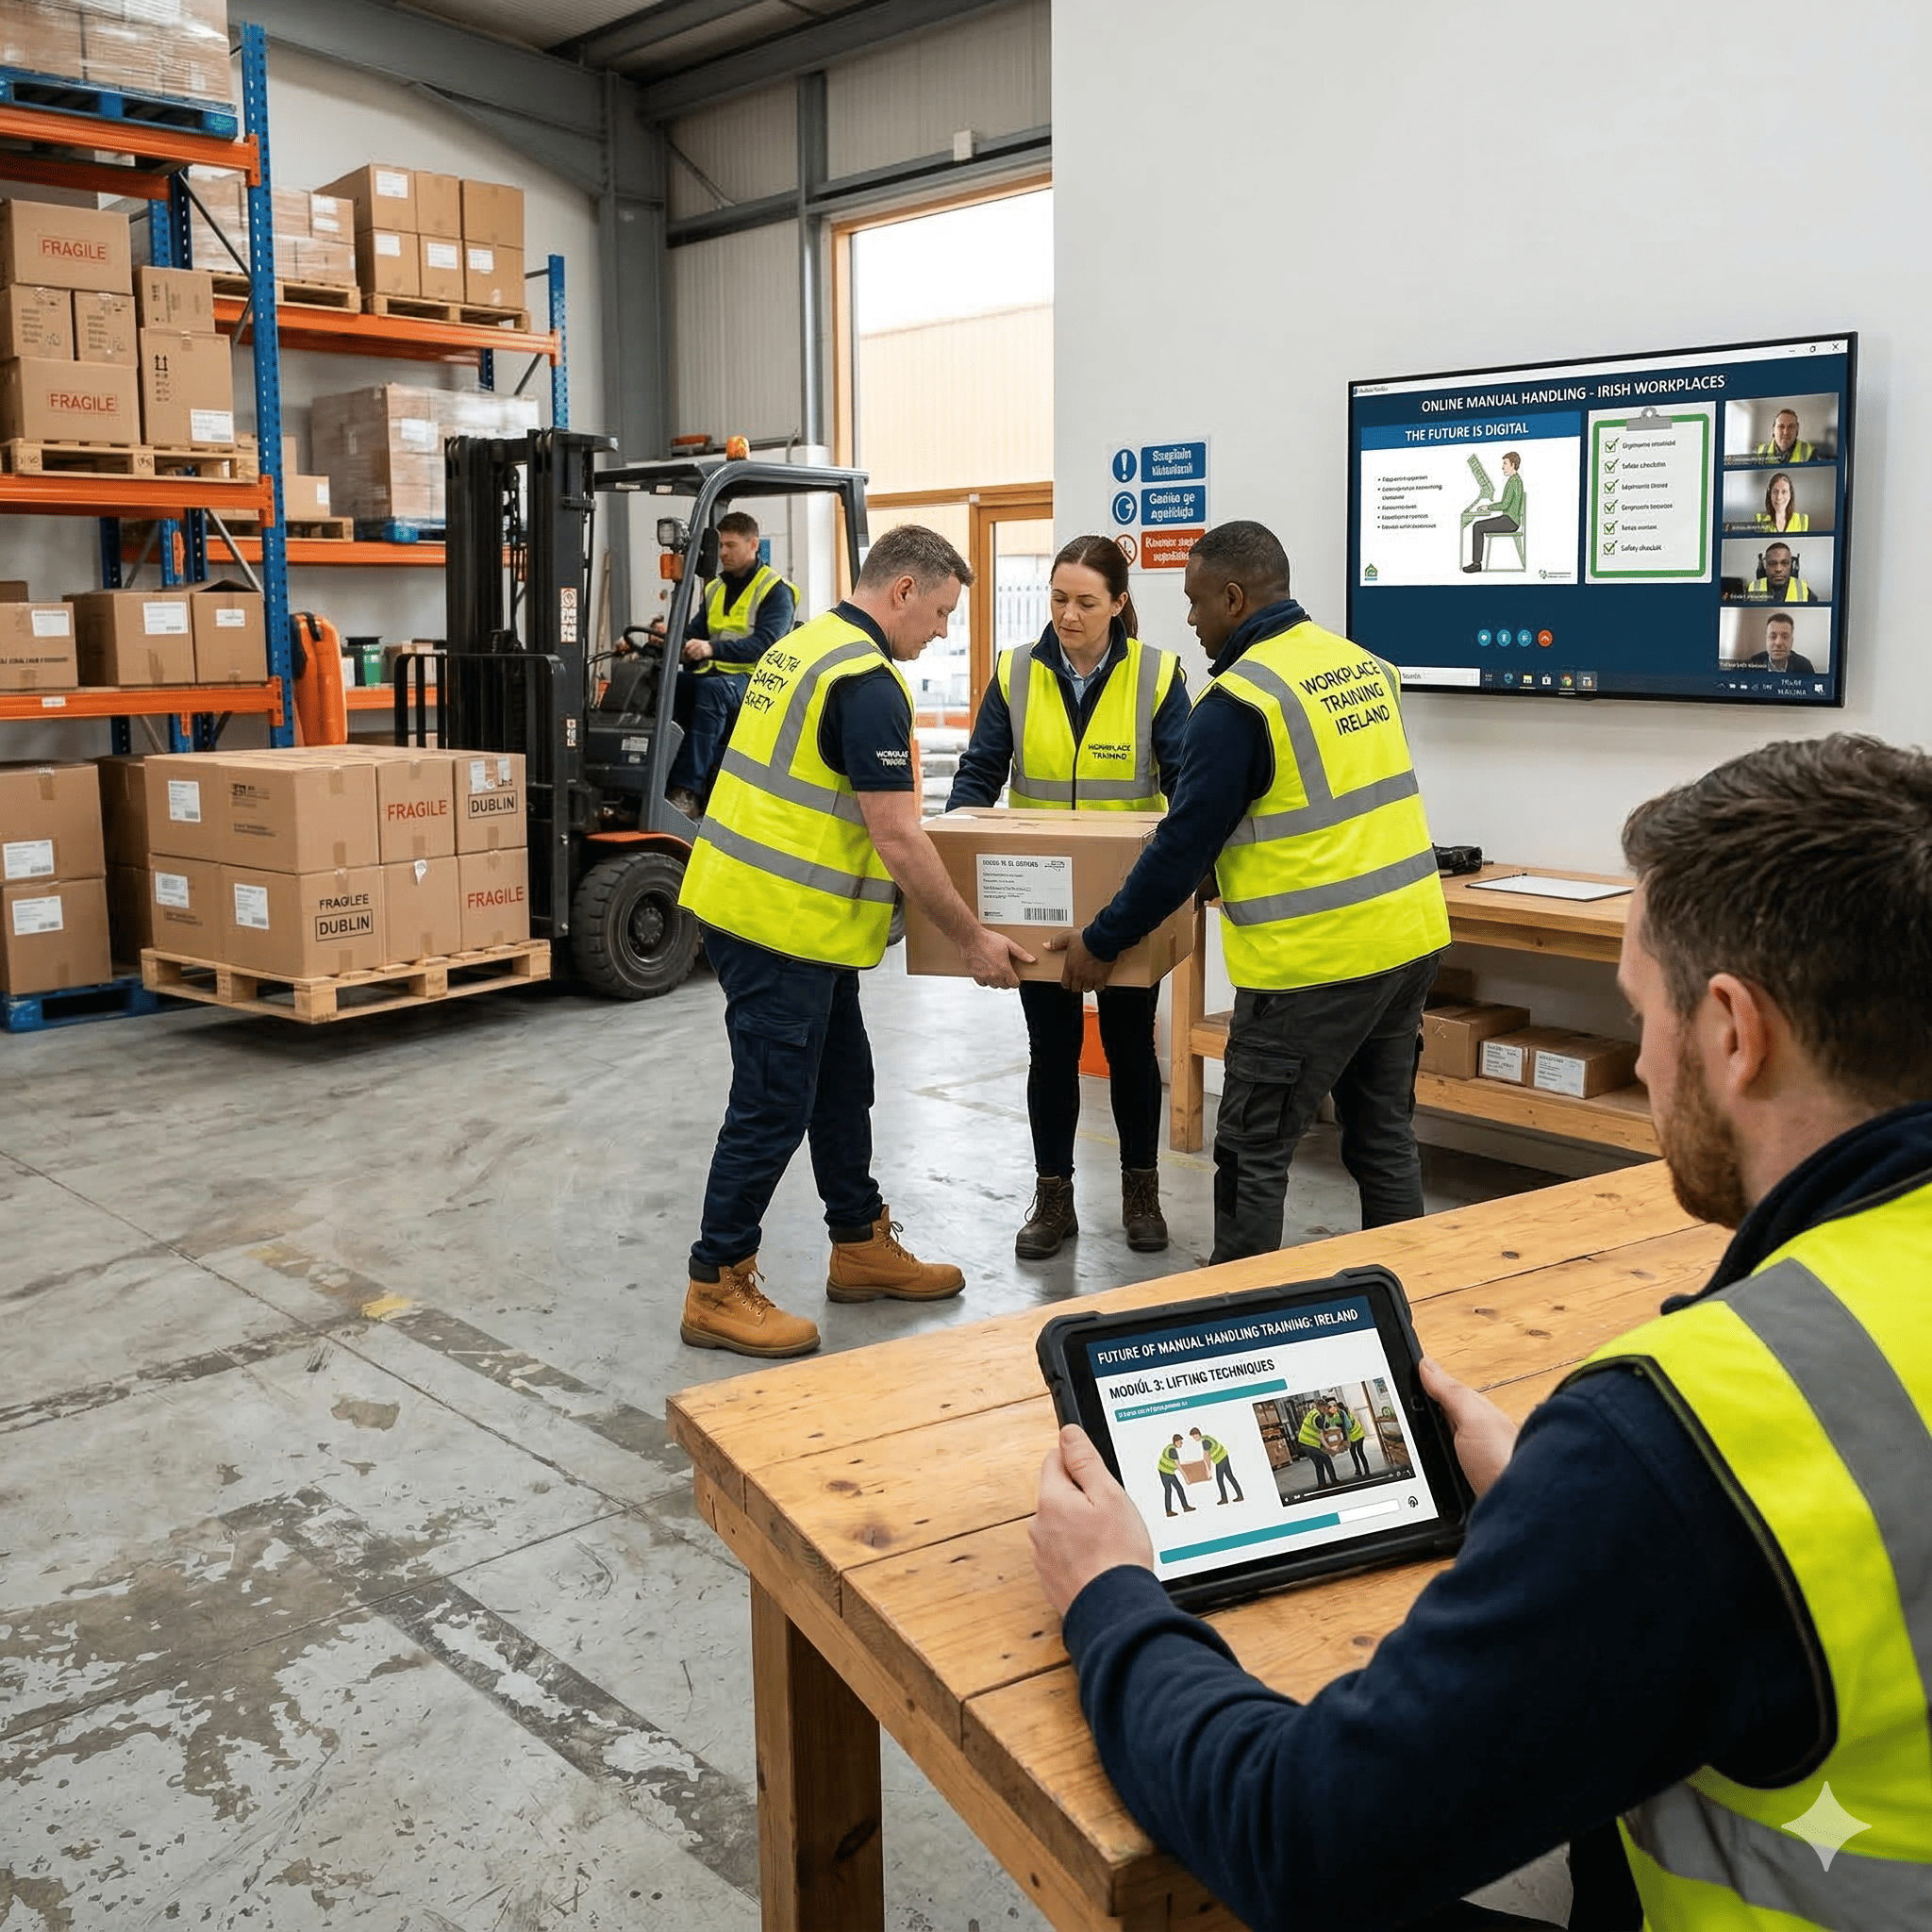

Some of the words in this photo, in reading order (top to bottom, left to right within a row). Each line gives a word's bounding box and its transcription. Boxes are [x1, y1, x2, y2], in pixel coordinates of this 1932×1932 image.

[42, 239, 107, 260] FRAGILE
[50, 392, 116, 412] FRAGILE
[1422, 397, 1463, 412] ONLINE
[1466, 393, 1519, 409] MANUAL
[1522, 387, 1587, 405] HANDLING
[1597, 382, 1631, 398] IRISH
[1634, 375, 1725, 395] WORKPLACES
[1406, 429, 1426, 441] THE
[1428, 425, 1470, 441] FUTURE
[1473, 425, 1482, 438] IS
[1485, 423, 1529, 437] DIGITAL
[753, 668, 789, 694] SAFETY
[1299, 660, 1381, 695] WORKPLACE
[1320, 682, 1384, 714] TRAINING
[1335, 705, 1391, 736] IRELAND
[387, 800, 448, 822] FRAGILE
[471, 795, 515, 813] DUBLIN
[467, 886, 525, 908] FRAGILE
[319, 915, 371, 936] DUBLIN
[1097, 1346, 1141, 1365] FUTURE
[1141, 1343, 1156, 1357] OF
[1157, 1335, 1205, 1355] MANUAL
[1204, 1325, 1260, 1346] HANDLING
[1259, 1317, 1314, 1336] TRAINING:
[1313, 1308, 1358, 1327] IRELAND
[1153, 1379, 1165, 1391] 3:
[1166, 1371, 1208, 1390] LIFTING
[1208, 1358, 1275, 1381] TECHNIQUES
